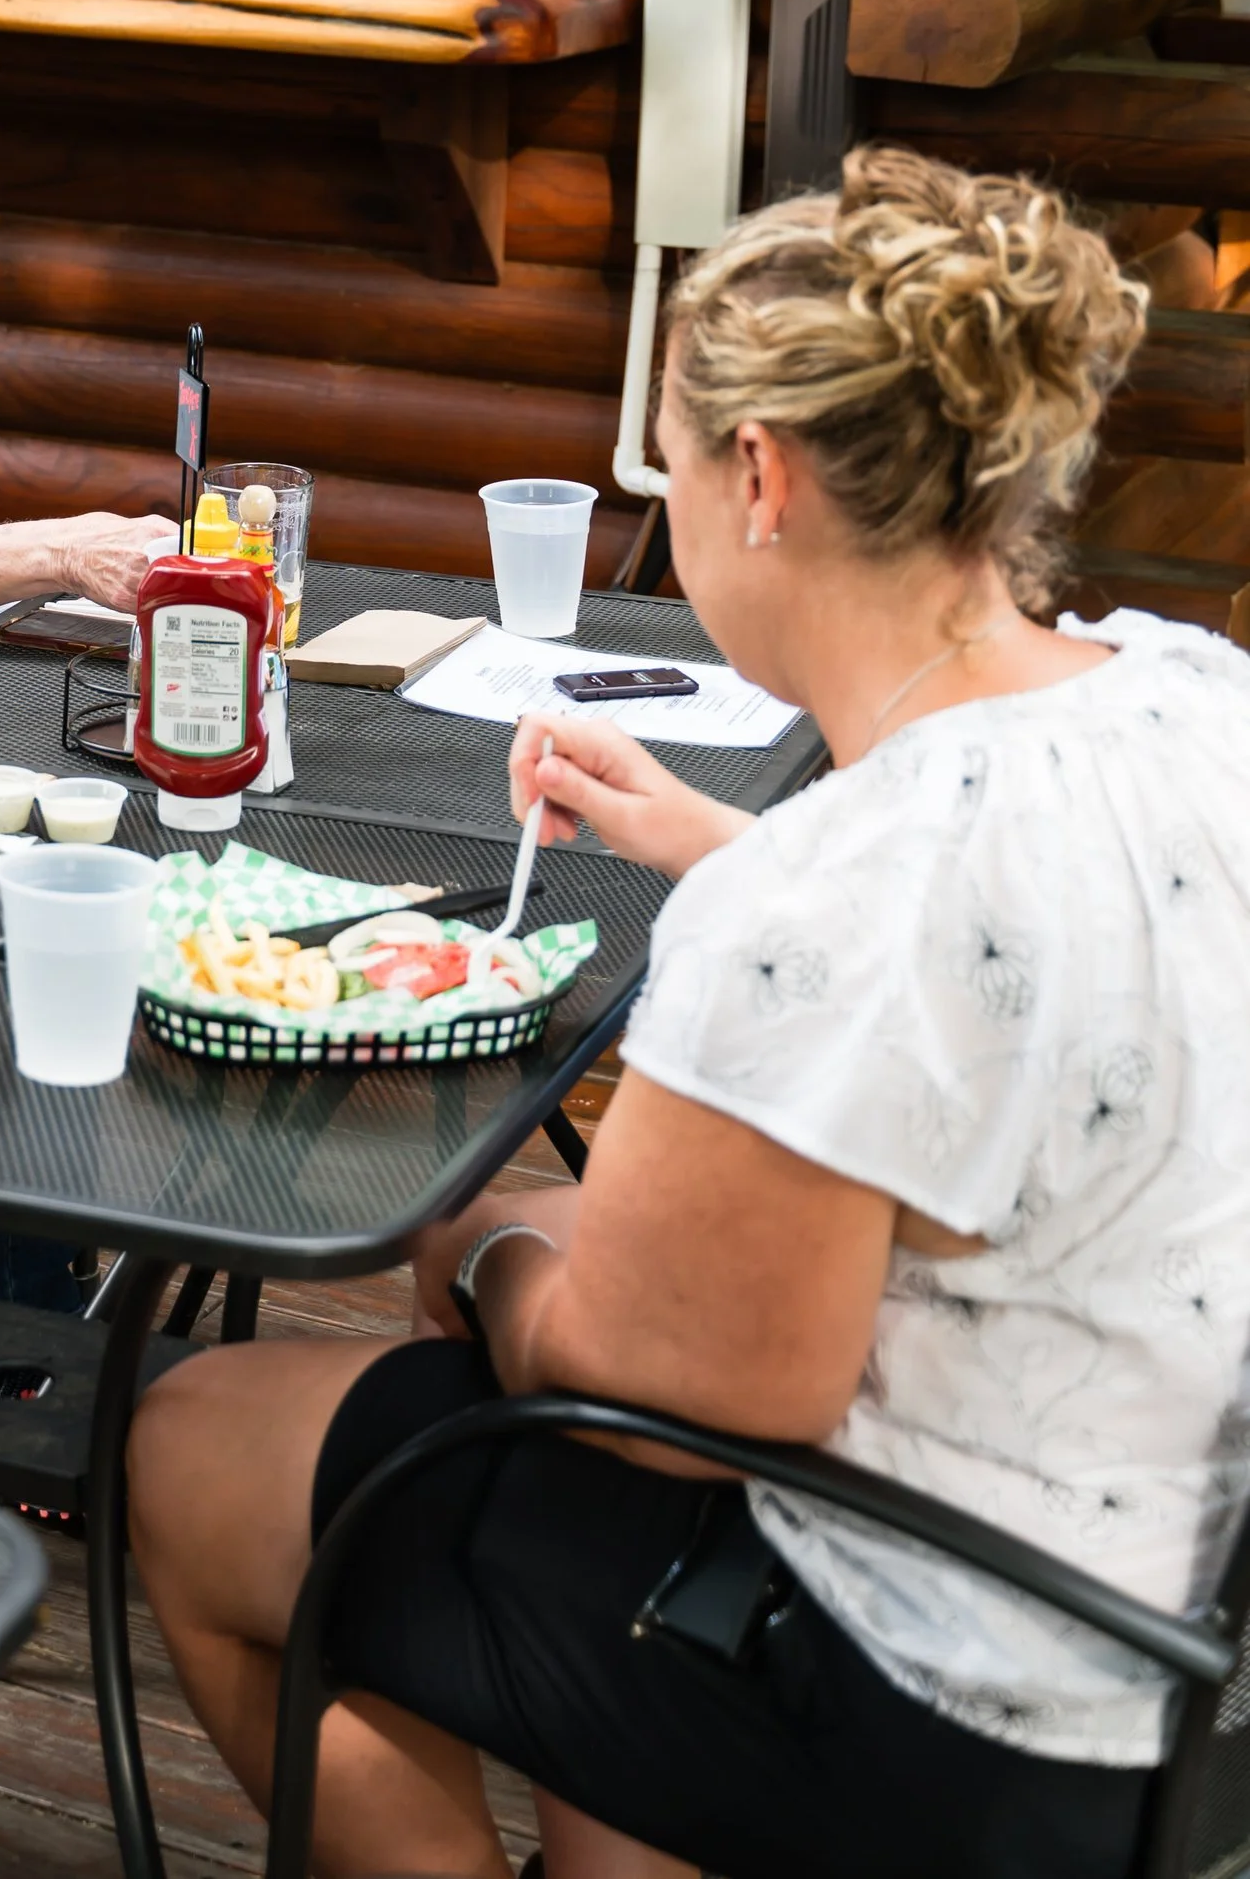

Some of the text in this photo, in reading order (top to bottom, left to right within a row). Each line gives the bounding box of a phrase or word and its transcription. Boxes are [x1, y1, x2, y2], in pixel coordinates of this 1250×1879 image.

[191, 619, 241, 628] Nutrition Facts
[229, 647, 240, 656] 20
